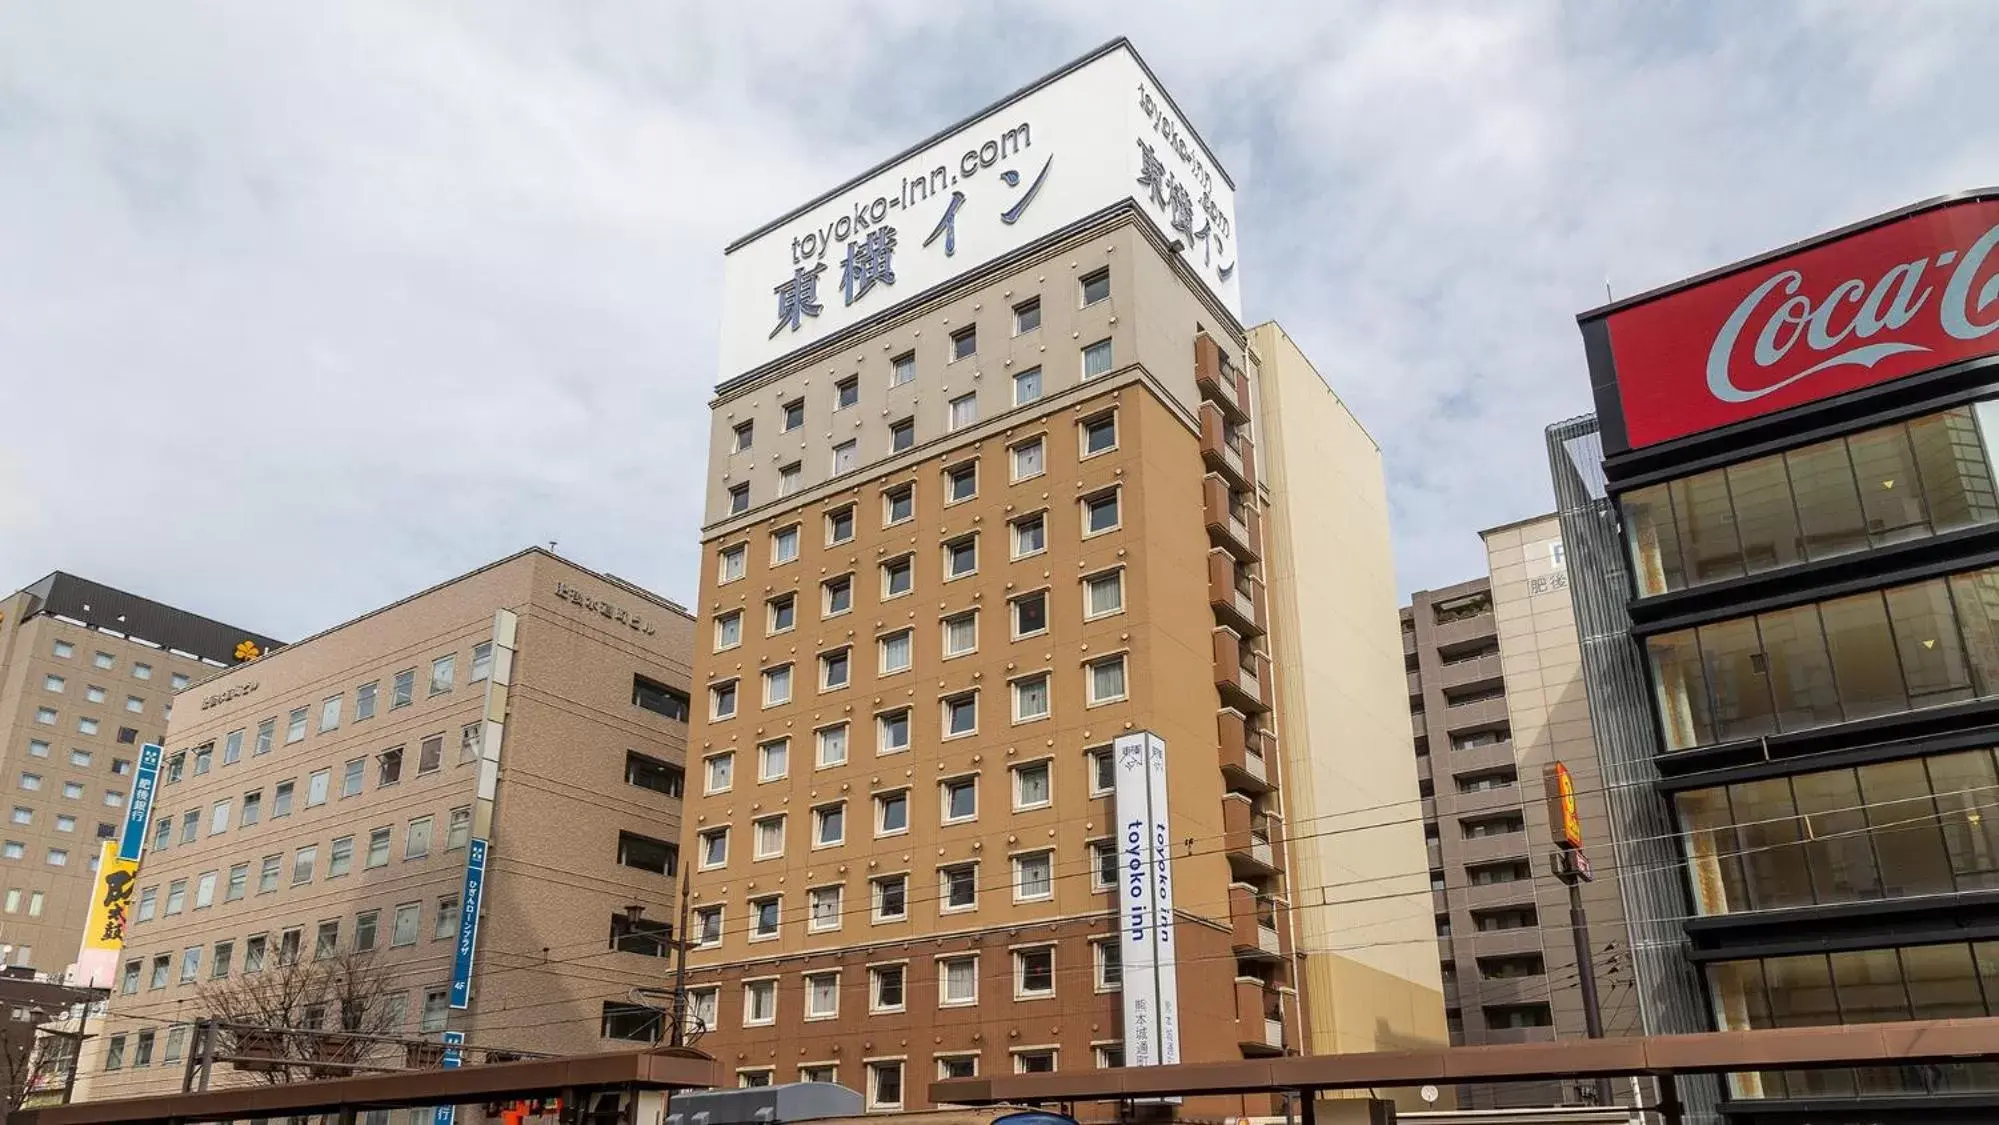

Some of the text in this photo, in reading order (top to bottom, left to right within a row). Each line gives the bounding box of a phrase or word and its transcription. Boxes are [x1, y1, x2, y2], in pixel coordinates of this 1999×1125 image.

[791, 122, 1031, 265] toyoko-inn.com
[1136, 136, 1235, 284] 東横イン
[1137, 82, 1230, 240] toyoko-inn.com
[769, 152, 1053, 341] 東横イン
[131, 778, 151, 822] 肥後銀行
[460, 880, 477, 956] ひぎんローンプラザ
[1125, 818, 1147, 941] toyoko inn
[1156, 823, 1170, 942] toyoko inn
